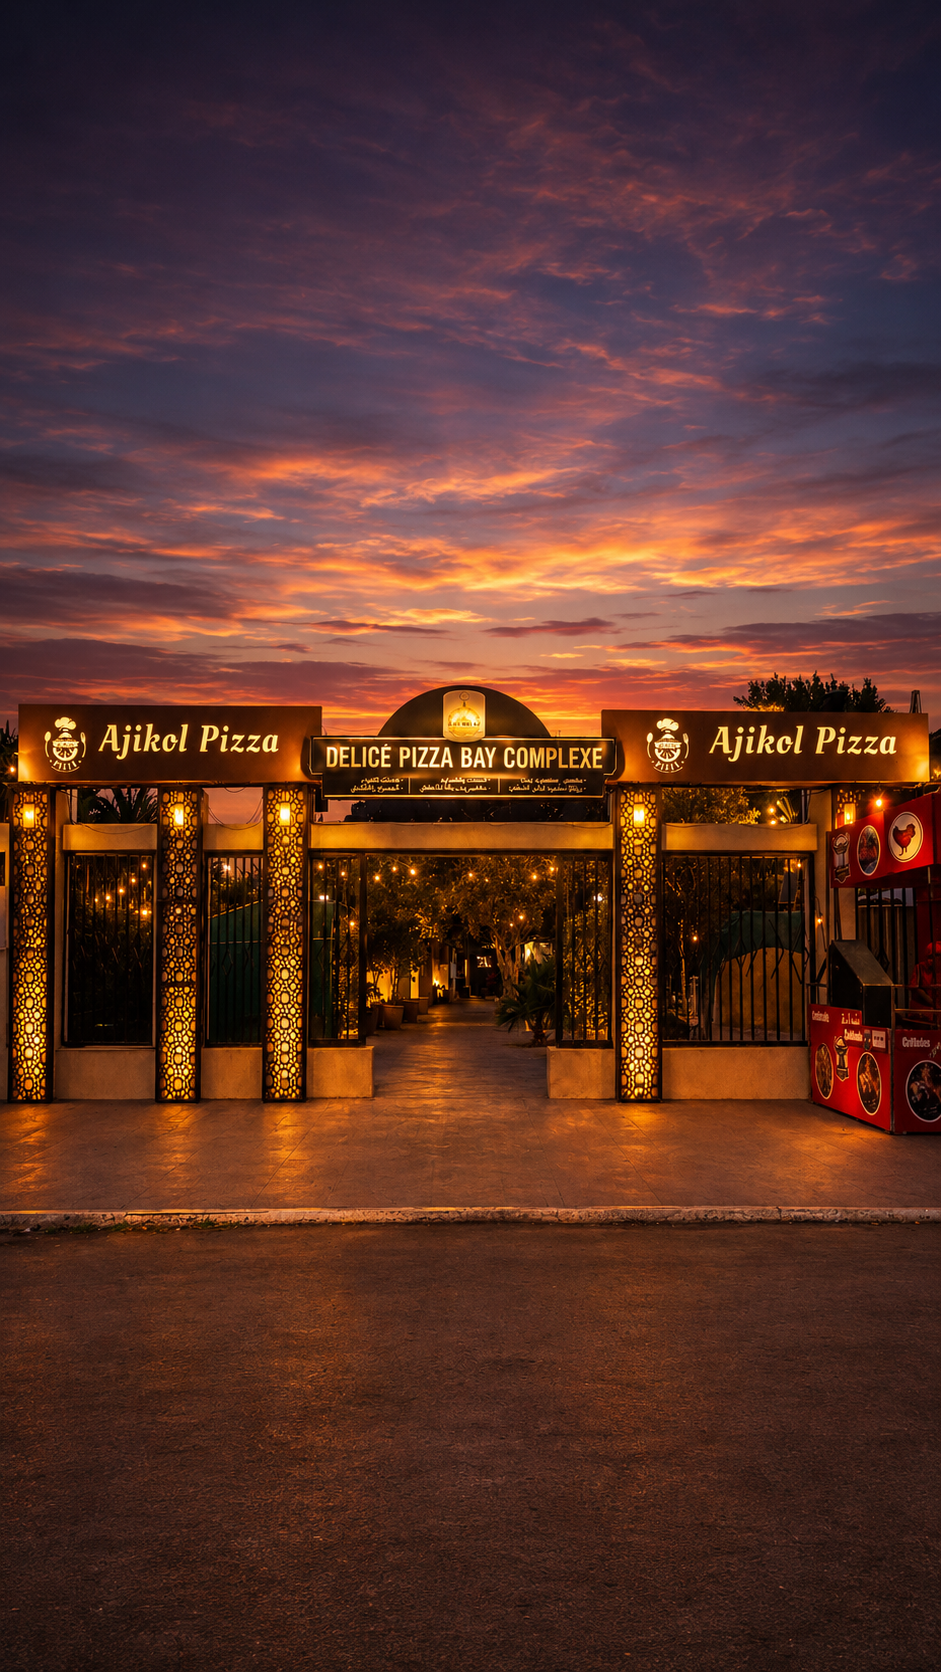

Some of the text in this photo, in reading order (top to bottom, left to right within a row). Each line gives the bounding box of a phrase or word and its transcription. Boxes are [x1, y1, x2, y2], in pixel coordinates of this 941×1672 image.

[98, 723, 280, 760] Ajikol Pizza
[326, 743, 604, 770] DELICÉ PIZZA BAY COMPLEXE
[708, 724, 898, 762] Ajikol Pizza
